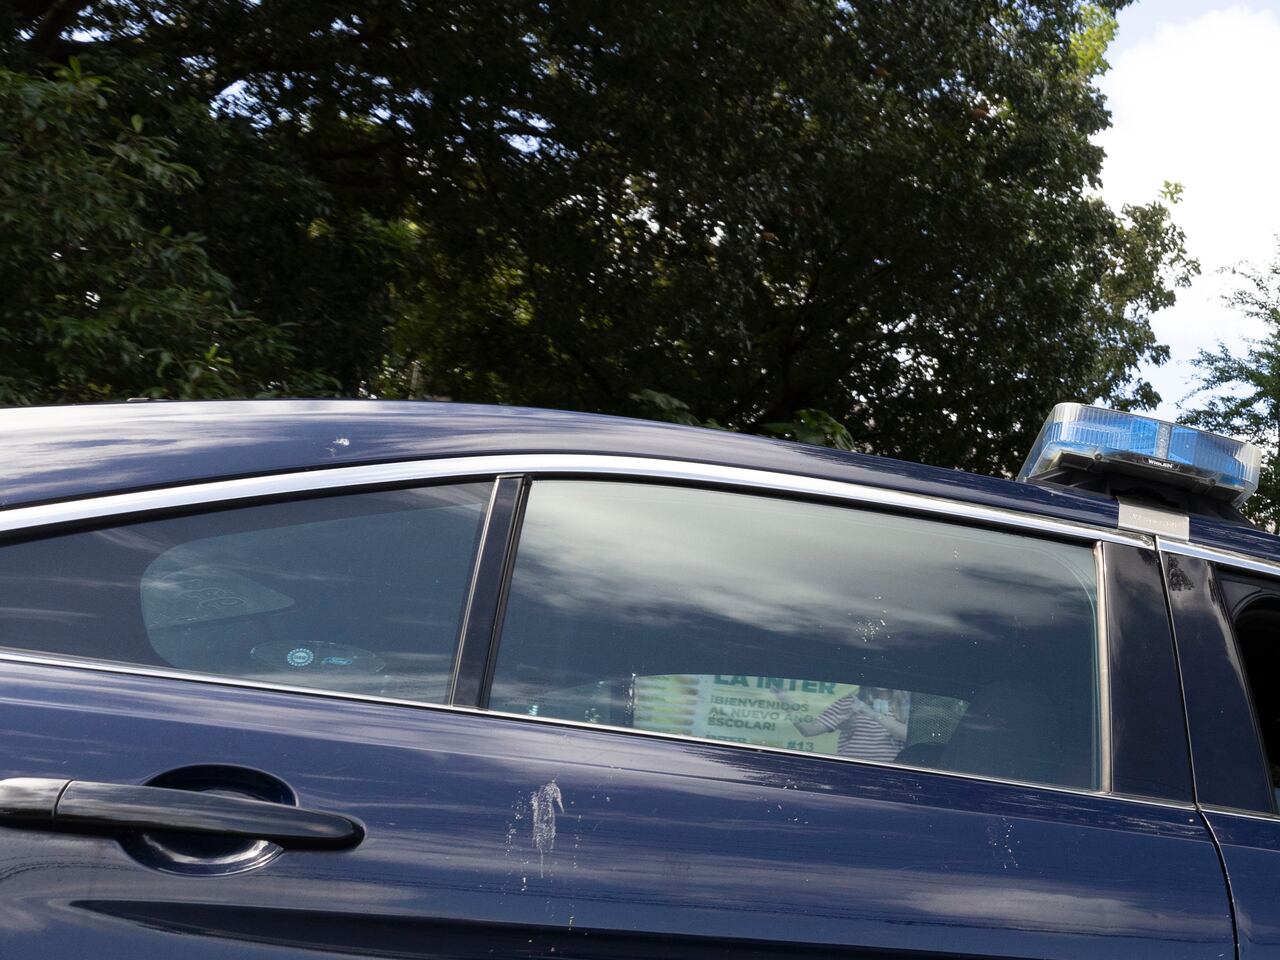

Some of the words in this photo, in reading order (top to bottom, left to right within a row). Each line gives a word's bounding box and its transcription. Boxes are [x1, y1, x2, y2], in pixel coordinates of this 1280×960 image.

[714, 675, 749, 687] LA
[757, 677, 837, 695] INTER
[709, 706, 727, 716] AL
[731, 708, 780, 721] NUEVO
[708, 717, 776, 731] ESCOLAR!
